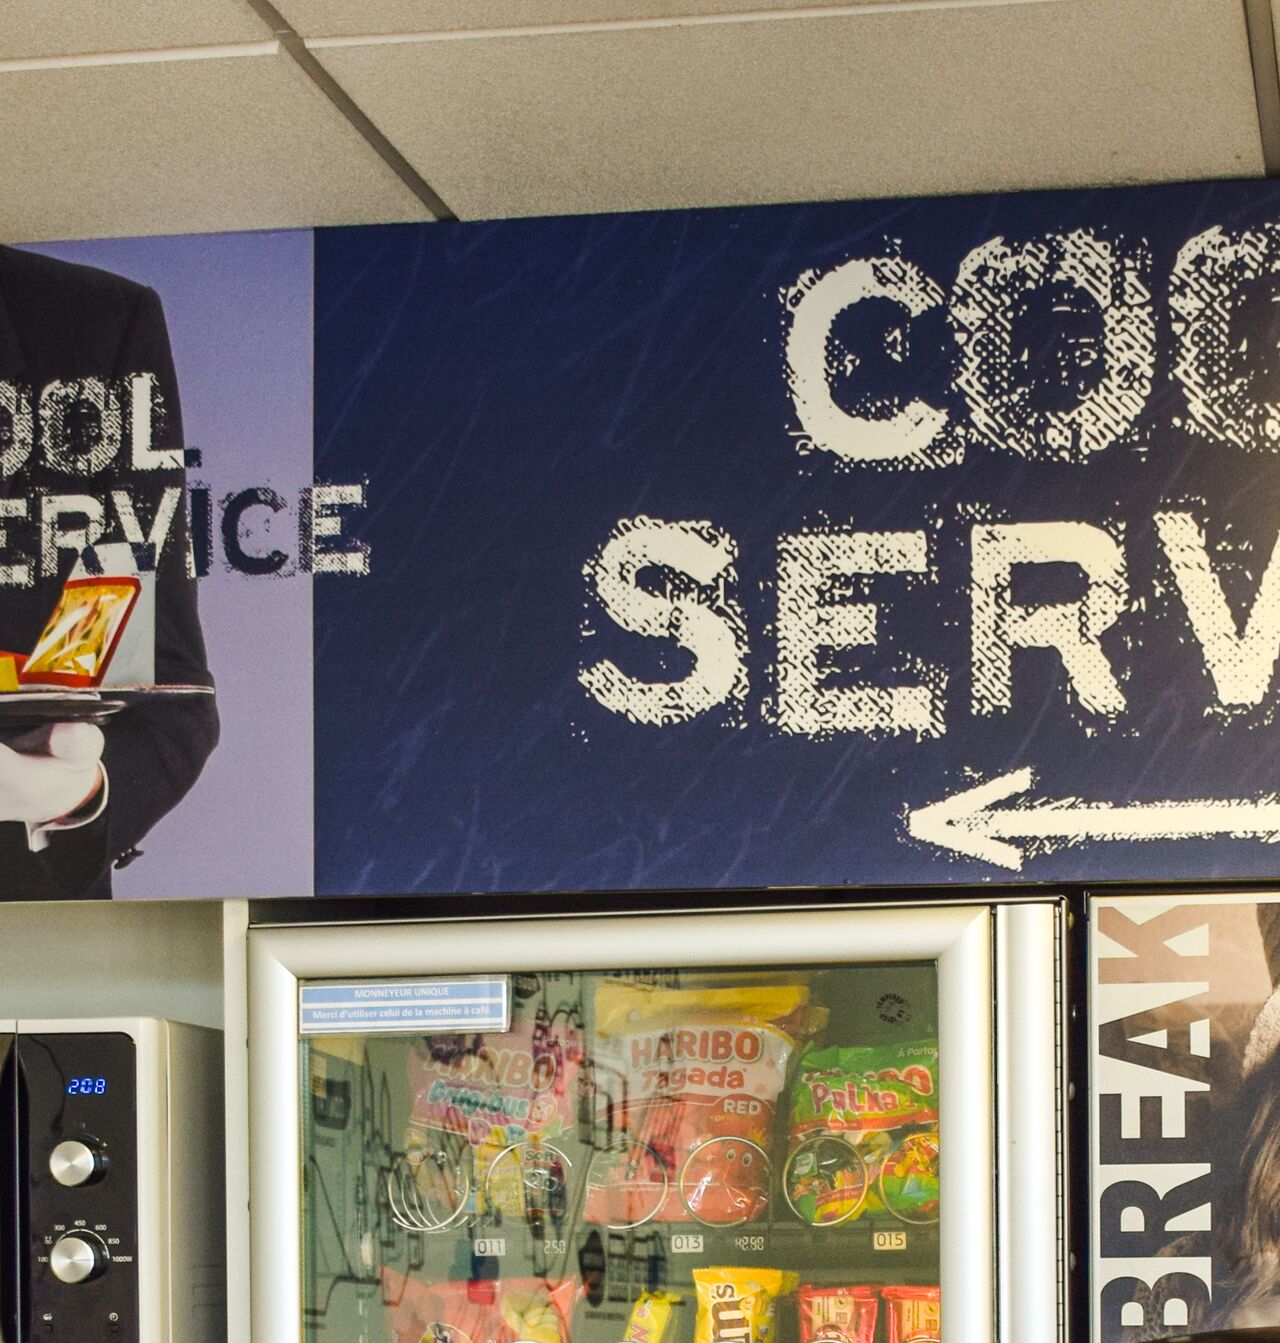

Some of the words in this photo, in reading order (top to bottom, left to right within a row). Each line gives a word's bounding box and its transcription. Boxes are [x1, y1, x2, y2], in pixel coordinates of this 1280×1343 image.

[414, 986, 449, 997] UNIQUE
[313, 1009, 338, 1020] Merci
[379, 1007, 400, 1018] celui
[401, 1007, 413, 1017] de
[415, 1007, 423, 1017] la
[424, 1006, 462, 1017] machine
[630, 1029, 762, 1069] HARIBO
[723, 1099, 761, 1116] RED
[673, 1236, 702, 1250] 013
[876, 1233, 905, 1247] 015
